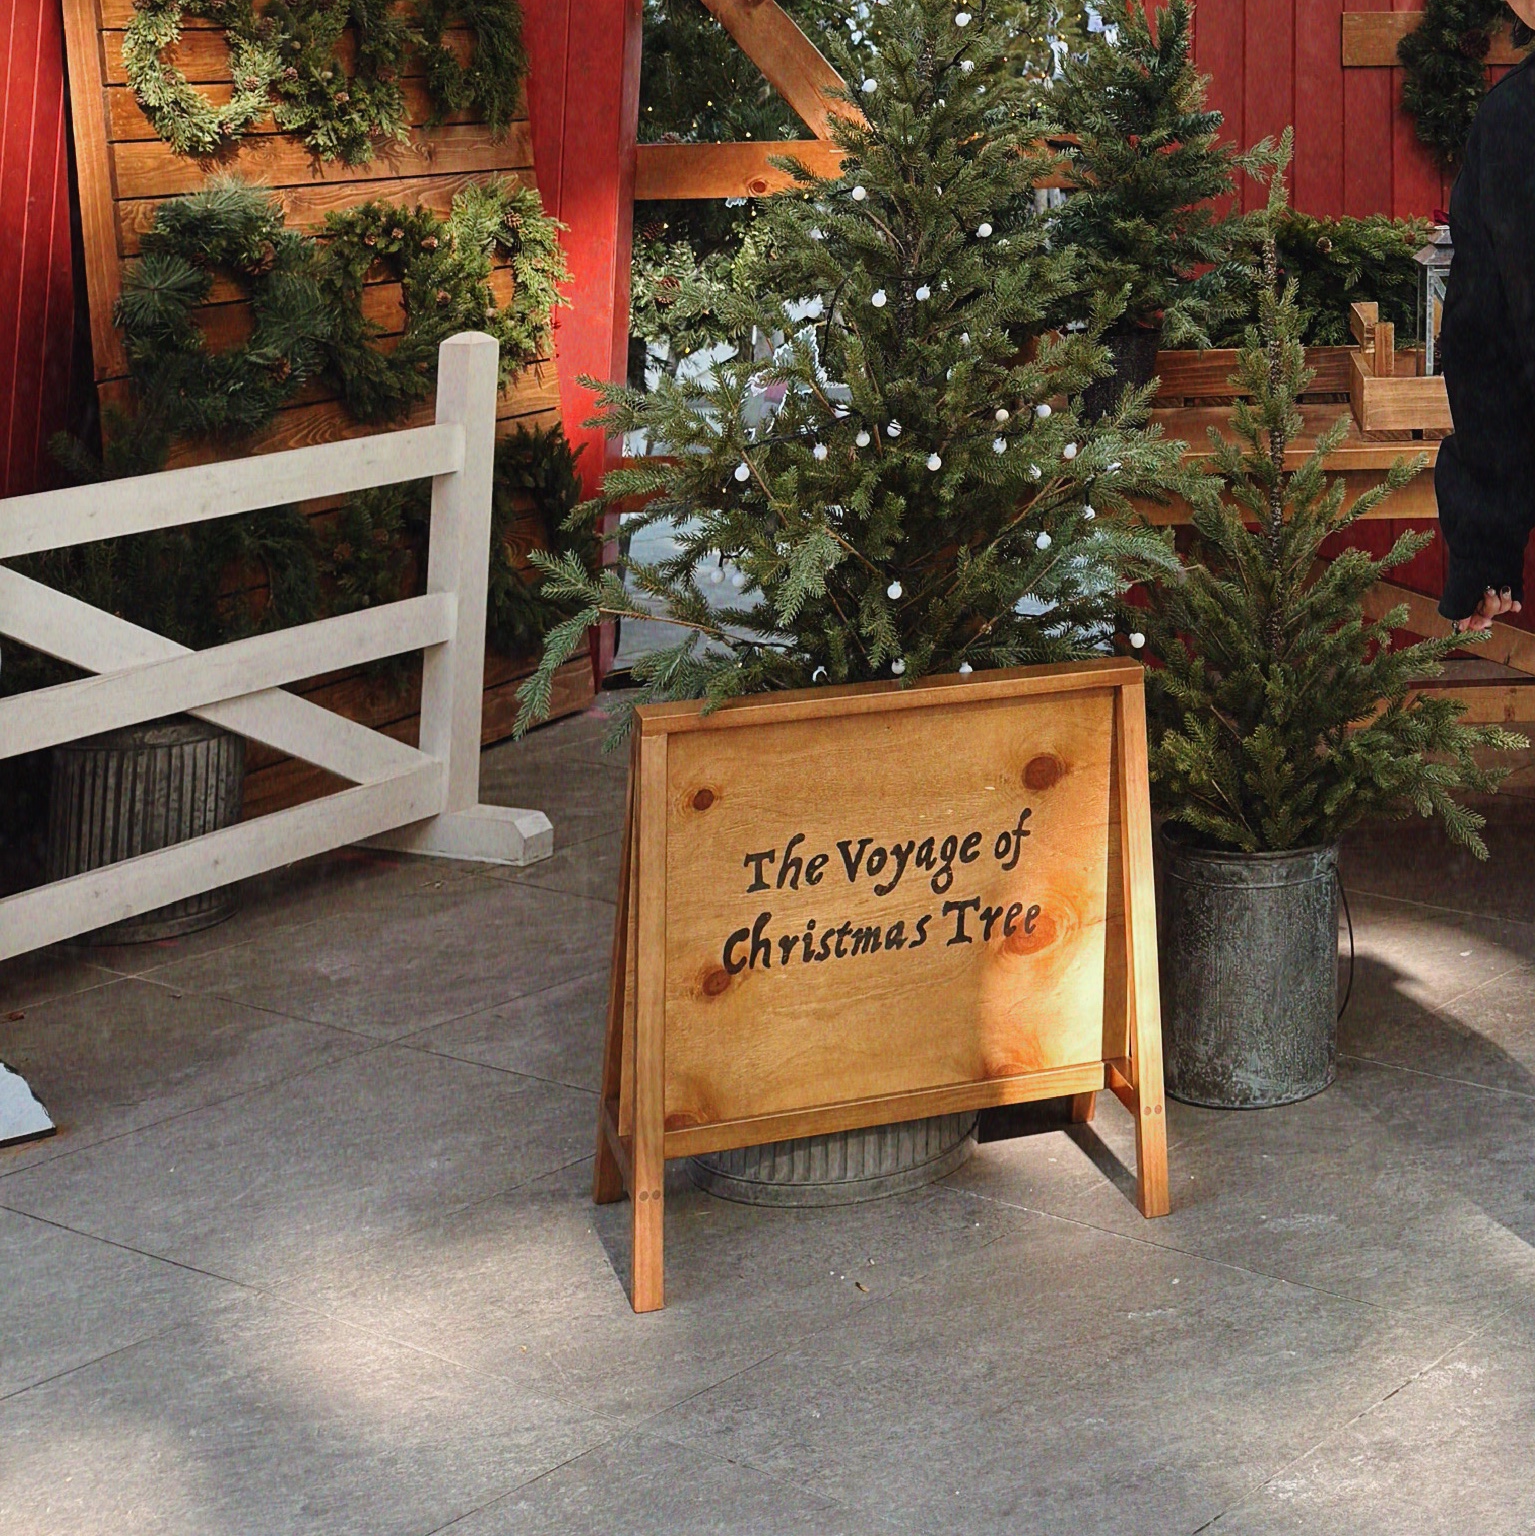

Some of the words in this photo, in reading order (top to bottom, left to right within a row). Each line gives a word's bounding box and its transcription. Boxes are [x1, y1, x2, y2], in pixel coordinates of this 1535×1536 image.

[744, 832, 829, 894] The
[836, 830, 982, 896] Voyage
[994, 807, 1032, 871] of
[722, 912, 933, 975] Christmas
[941, 896, 1042, 948] Tree
